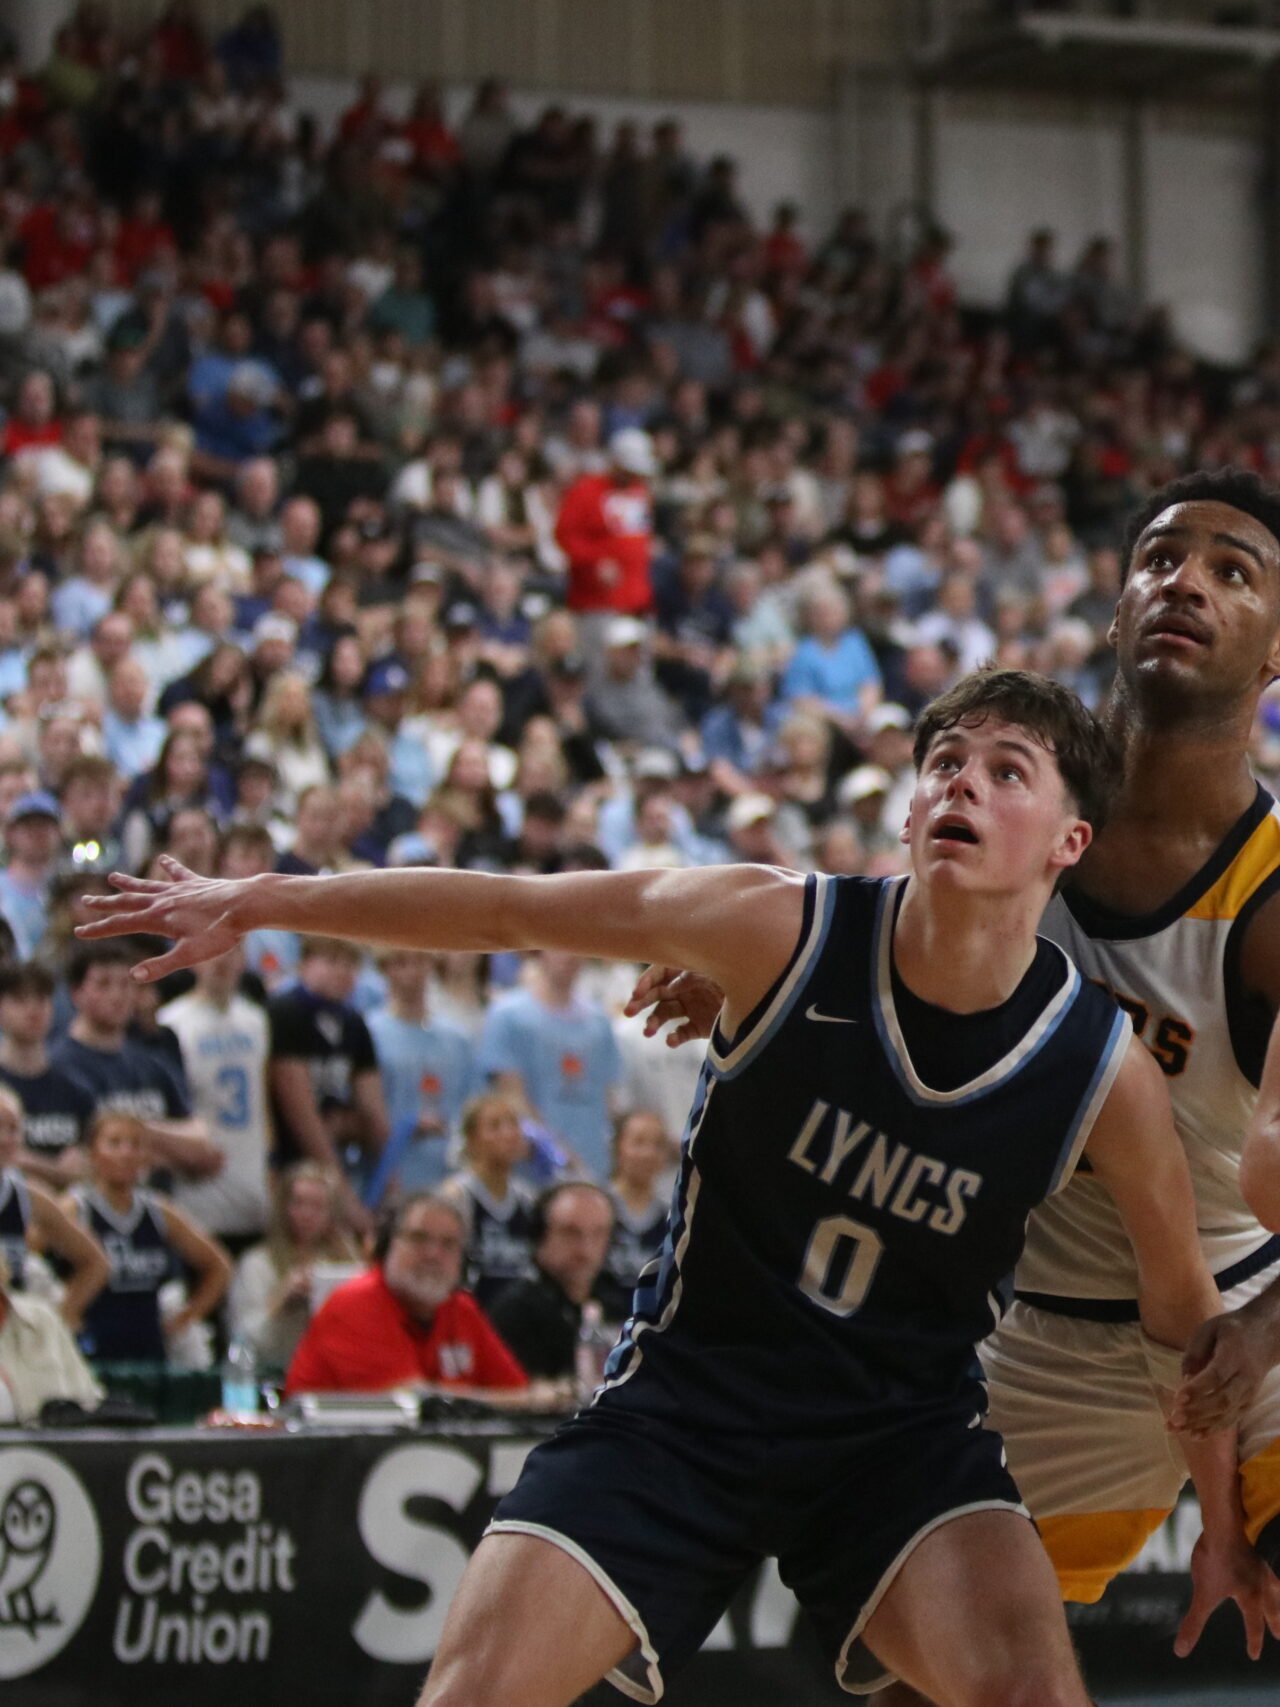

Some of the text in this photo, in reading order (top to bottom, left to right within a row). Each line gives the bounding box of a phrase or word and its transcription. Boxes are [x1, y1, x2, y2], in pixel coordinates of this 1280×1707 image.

[215, 1064, 251, 1128] 3
[787, 1099, 982, 1236] LYNCS
[799, 1214, 885, 1318] 0
[124, 1455, 263, 1524] Gesa
[121, 1521, 297, 1596] Credit
[112, 1594, 273, 1665] Union
